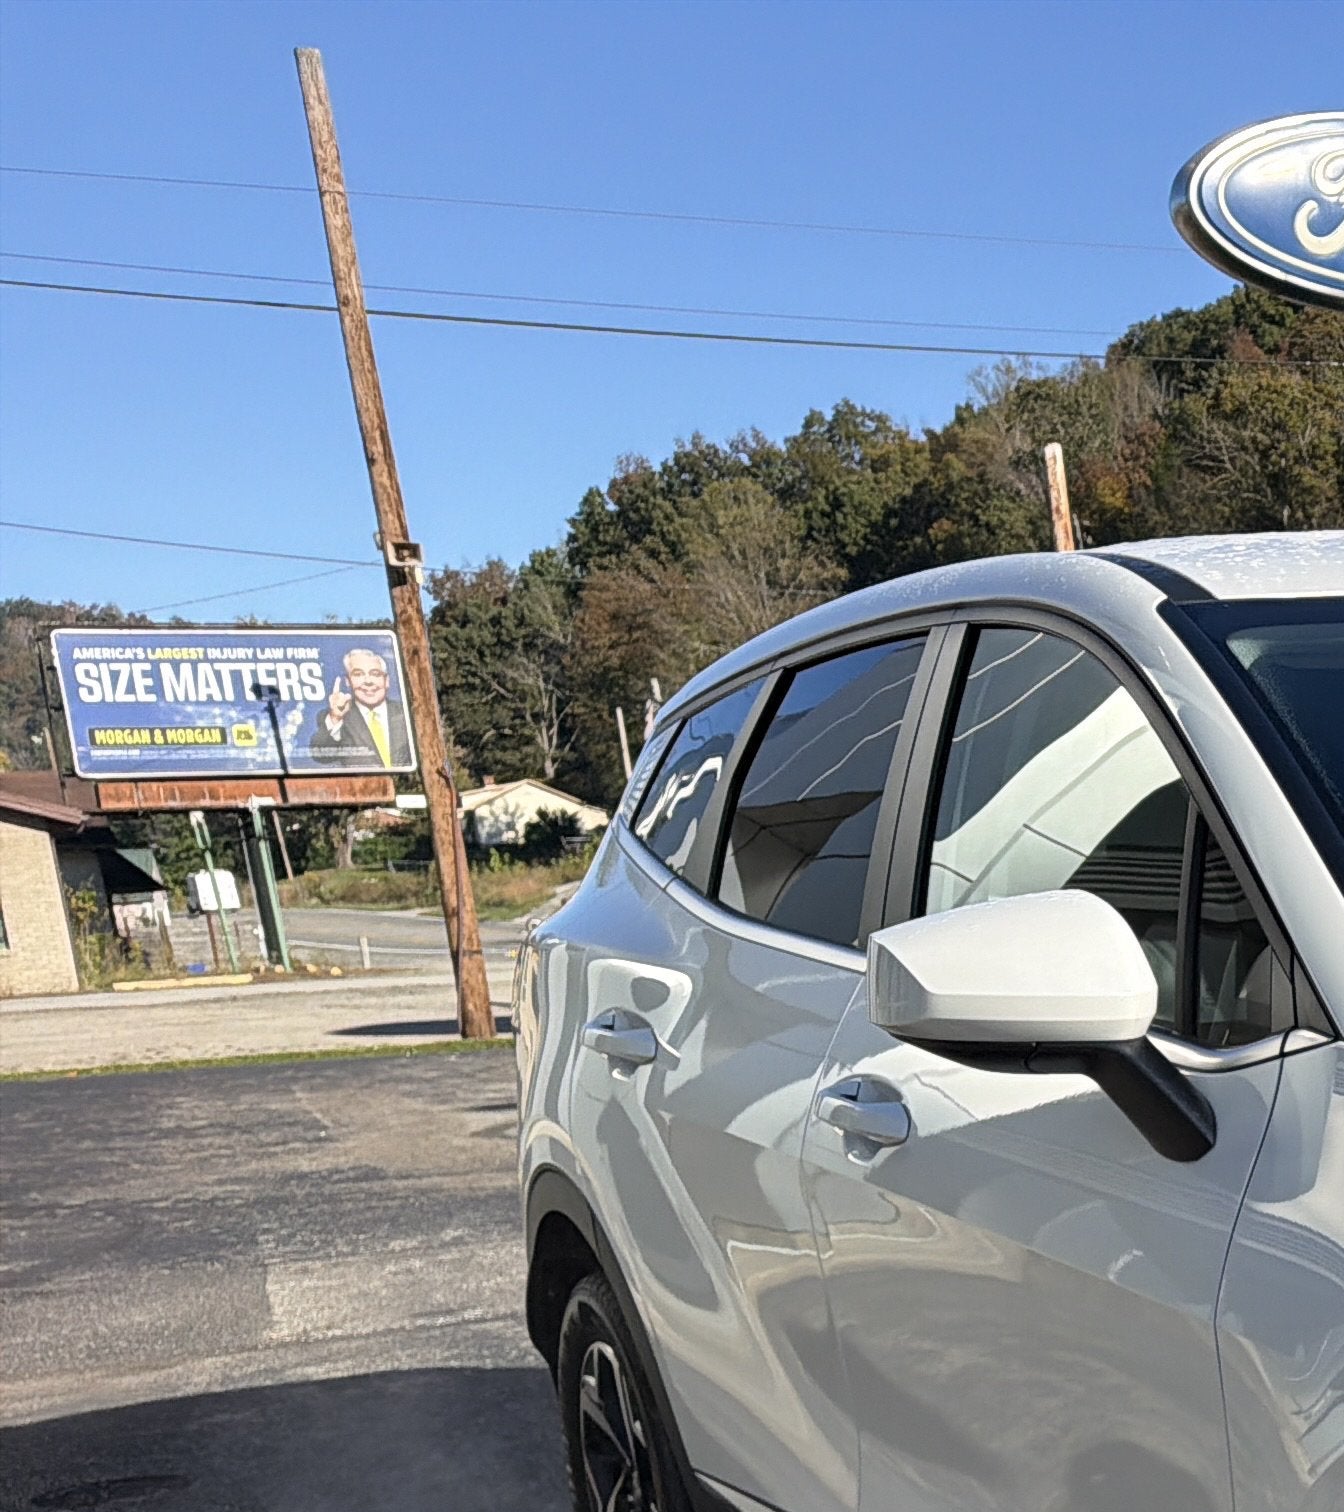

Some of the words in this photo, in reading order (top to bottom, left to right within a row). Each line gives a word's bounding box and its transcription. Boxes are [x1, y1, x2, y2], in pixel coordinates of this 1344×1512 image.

[72, 647, 146, 660] AMERICA'S
[147, 647, 205, 660] LARGEST
[207, 647, 254, 660] INJURY
[256, 647, 285, 660] LAW
[74, 662, 157, 703] SIZE
[160, 662, 326, 702] MATTERS
[94, 728, 151, 746] MORGAN
[154, 728, 164, 745] &
[166, 727, 222, 745] MORGAN
